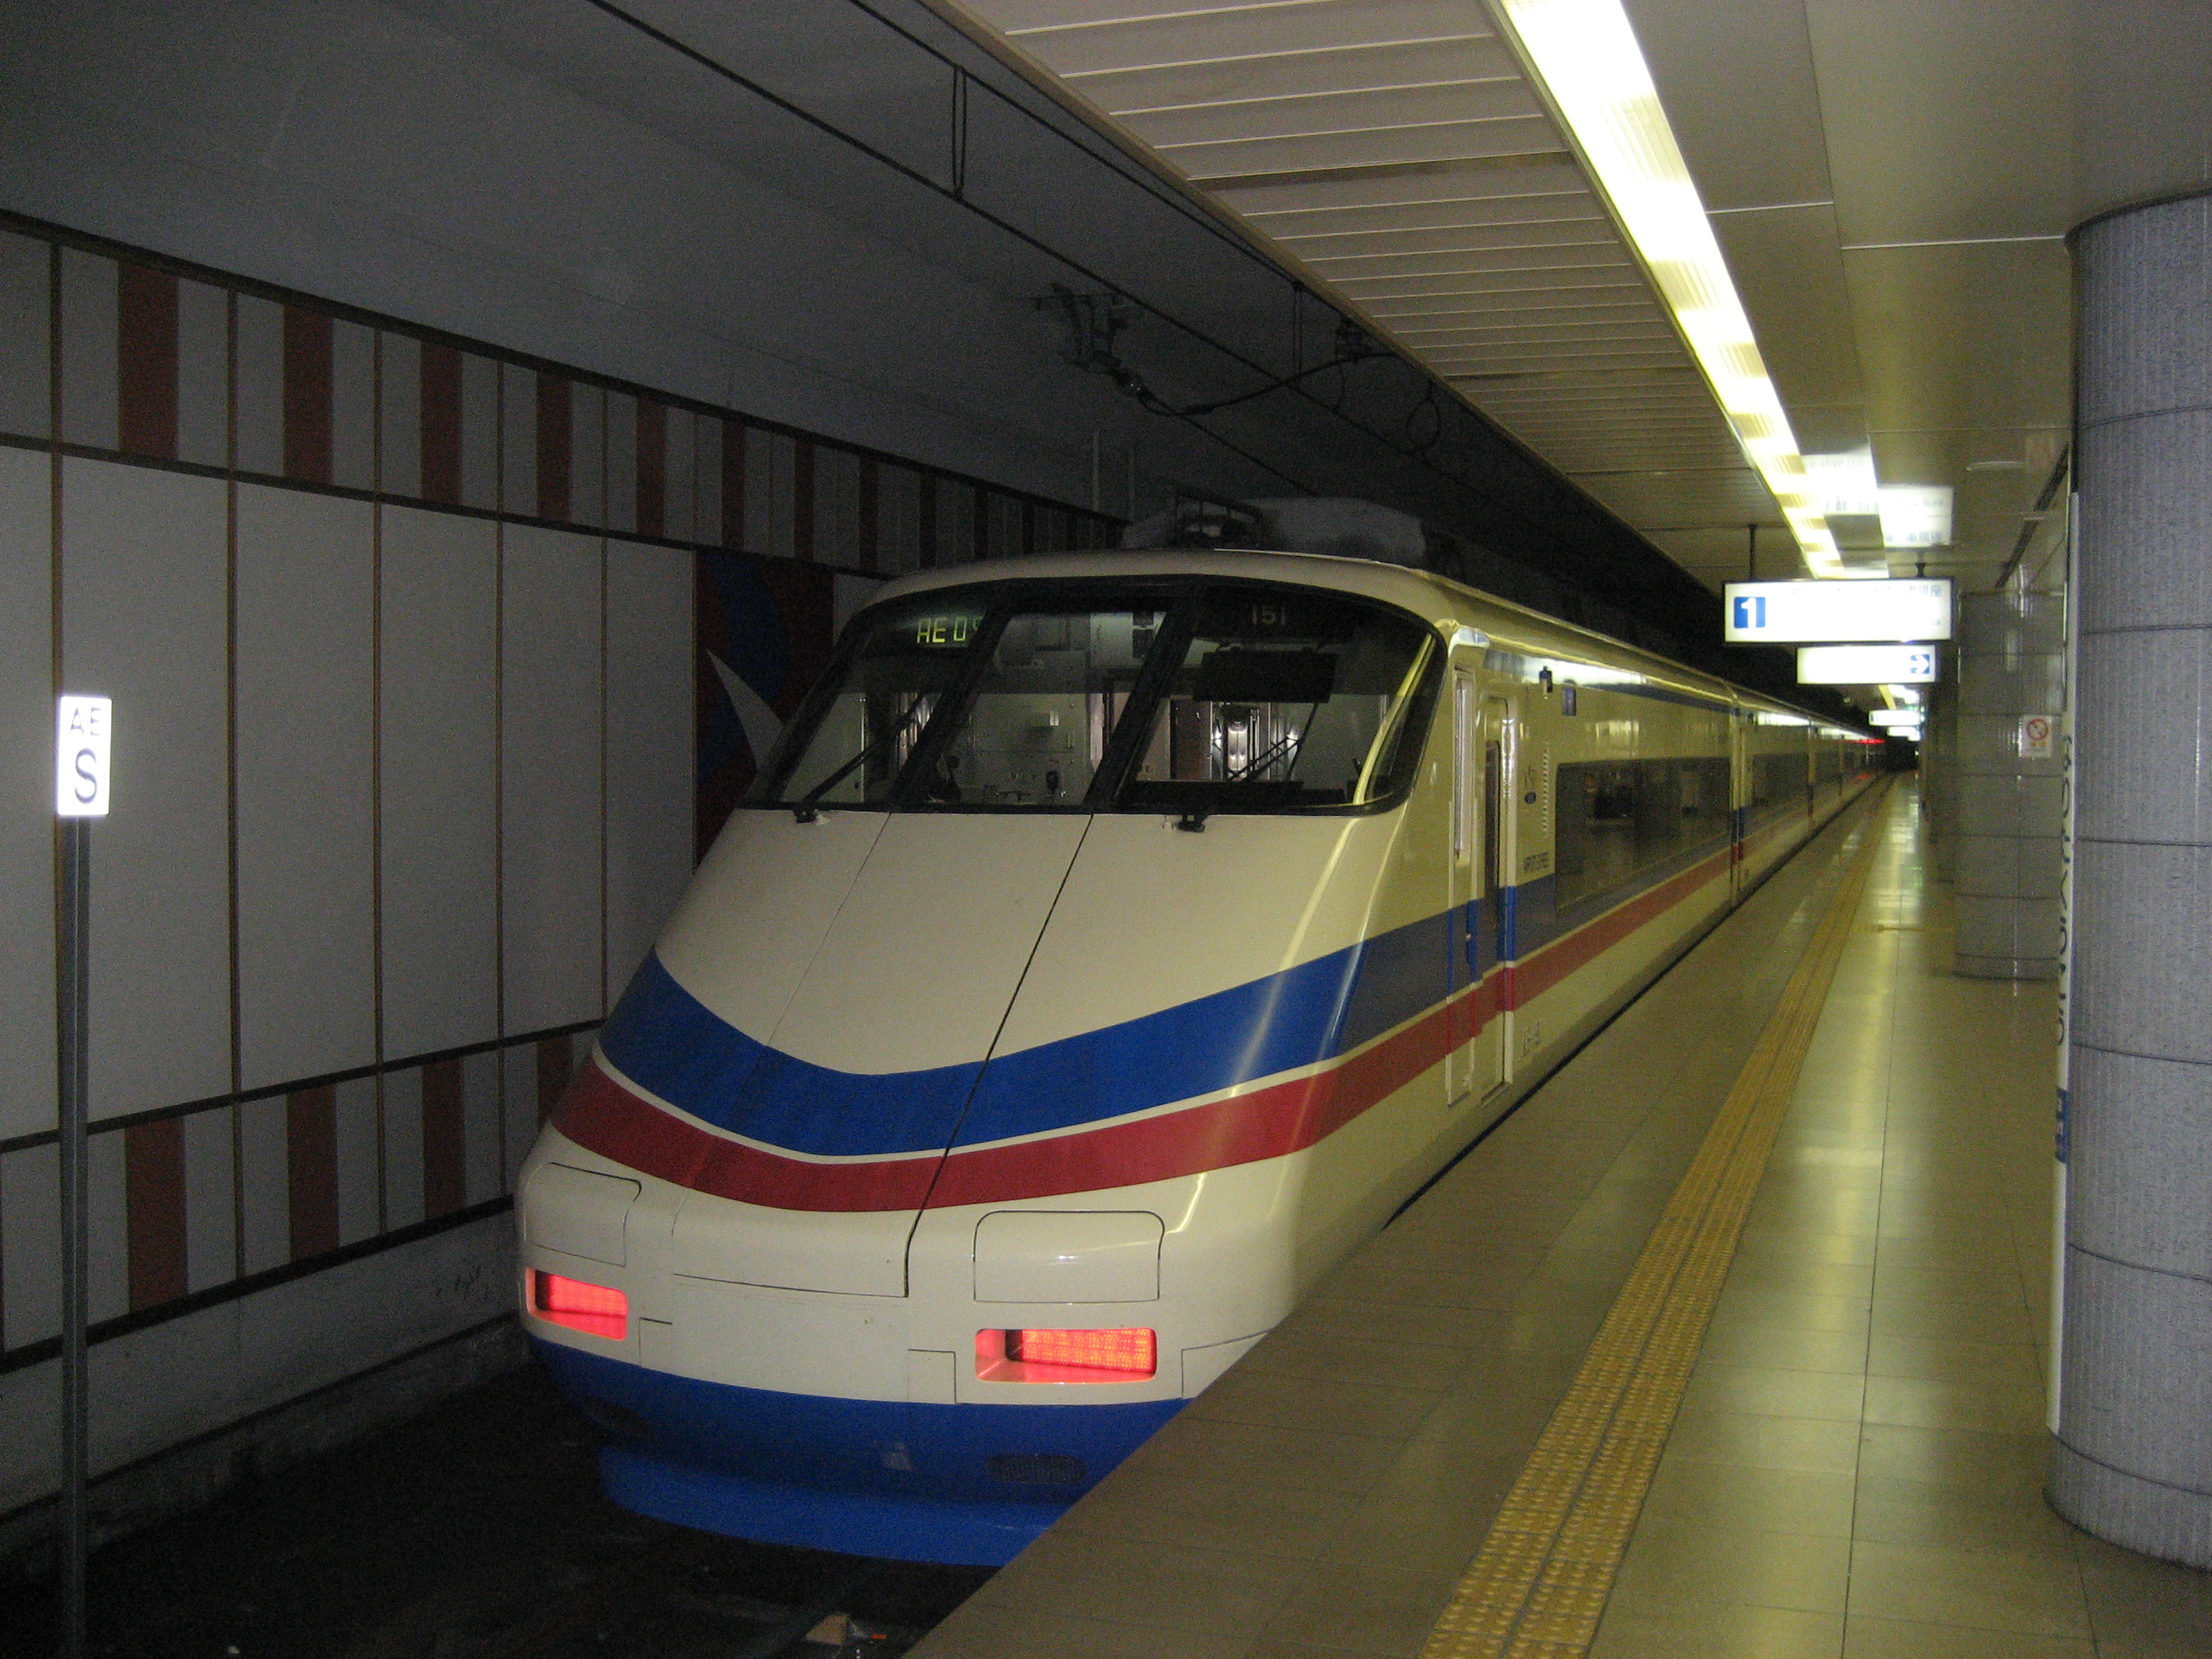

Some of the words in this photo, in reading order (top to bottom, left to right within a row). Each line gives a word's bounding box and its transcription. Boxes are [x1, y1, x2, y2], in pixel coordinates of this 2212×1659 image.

[1741, 597, 1757, 628] 1
[70, 707, 101, 736] AE
[74, 747, 97, 805] S
